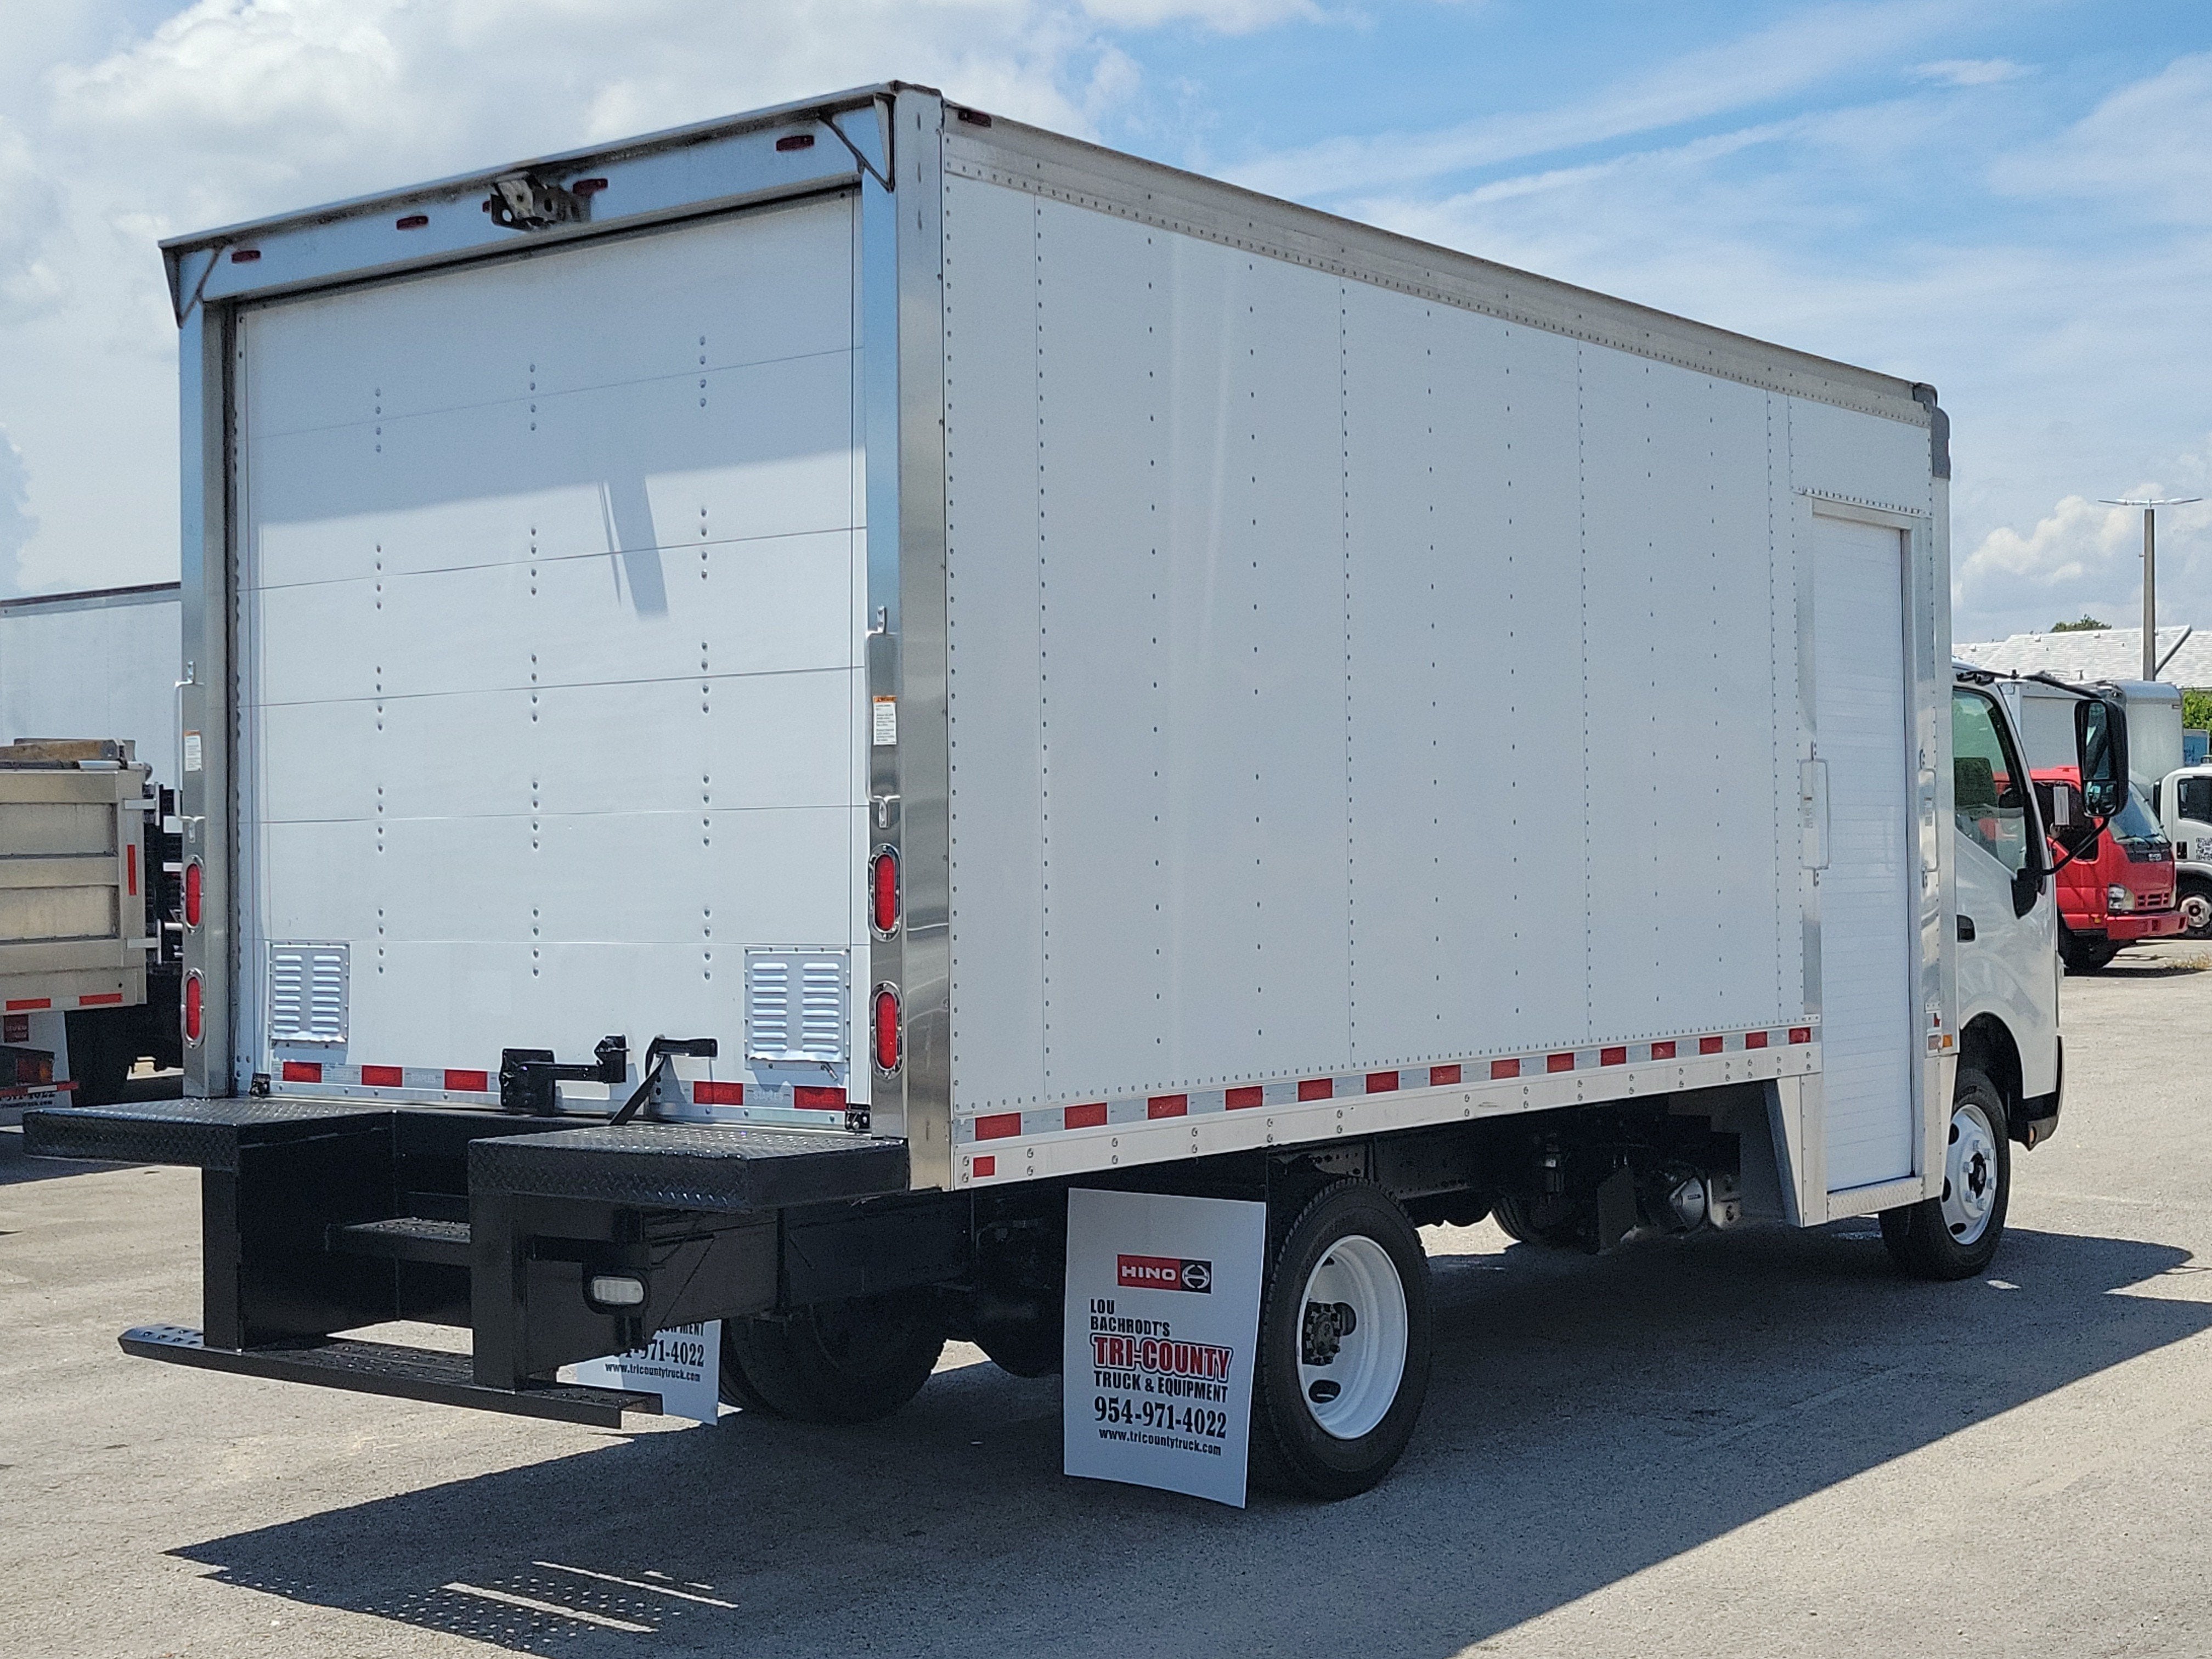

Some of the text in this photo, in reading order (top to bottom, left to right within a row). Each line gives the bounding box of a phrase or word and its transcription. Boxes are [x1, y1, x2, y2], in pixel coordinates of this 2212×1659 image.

[1121, 1265, 1177, 1282] HINO
[1090, 1298, 1115, 1315] LOU
[1090, 1316, 1171, 1337] BACHRODT'S
[1092, 1335, 1232, 1381] TRI-COUNTY
[1093, 1370, 1228, 1403] TRUCK & EQUIPMENT
[1094, 1395, 1227, 1440] 954-971-4022
[1098, 1427, 1222, 1456] www.tricountytruck.com
